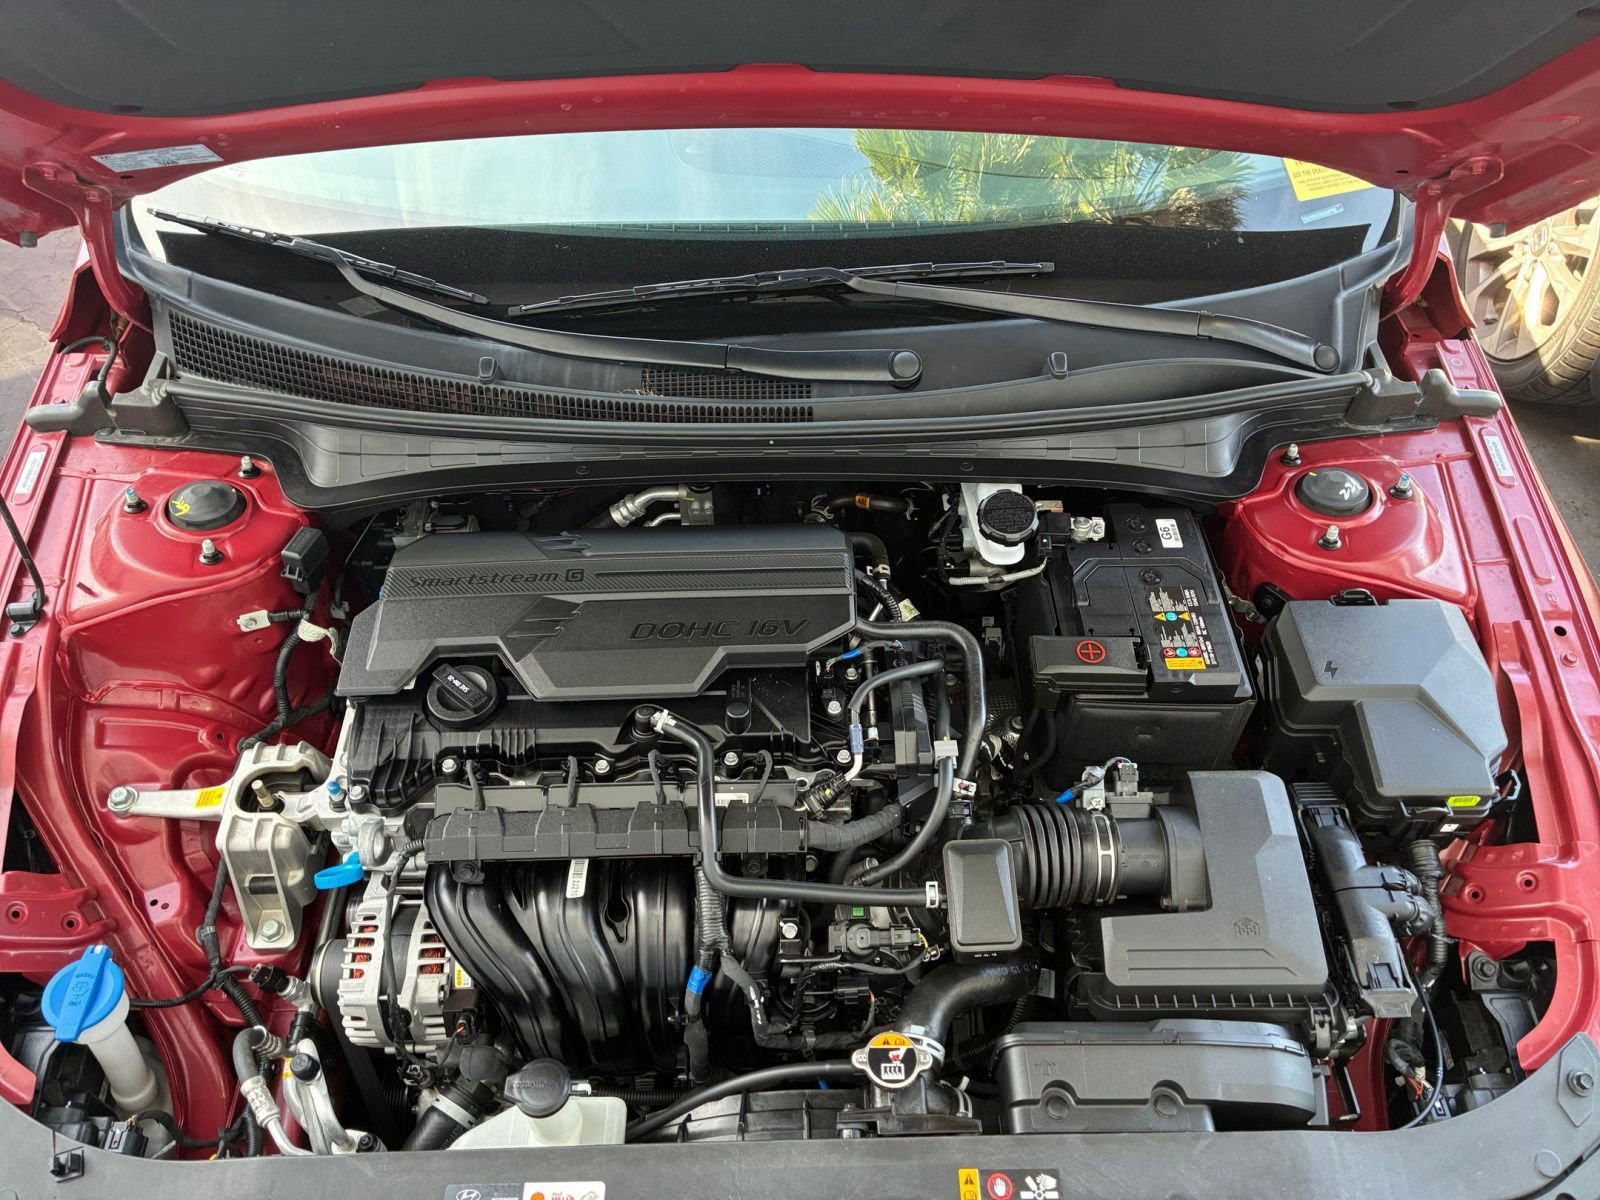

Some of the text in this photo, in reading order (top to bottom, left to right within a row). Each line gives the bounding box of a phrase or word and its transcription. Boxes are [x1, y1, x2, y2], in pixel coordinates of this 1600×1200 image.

[1160, 526, 1172, 540] G6
[408, 571, 559, 589] Smartstream
[629, 618, 809, 641] DOHC 16V
